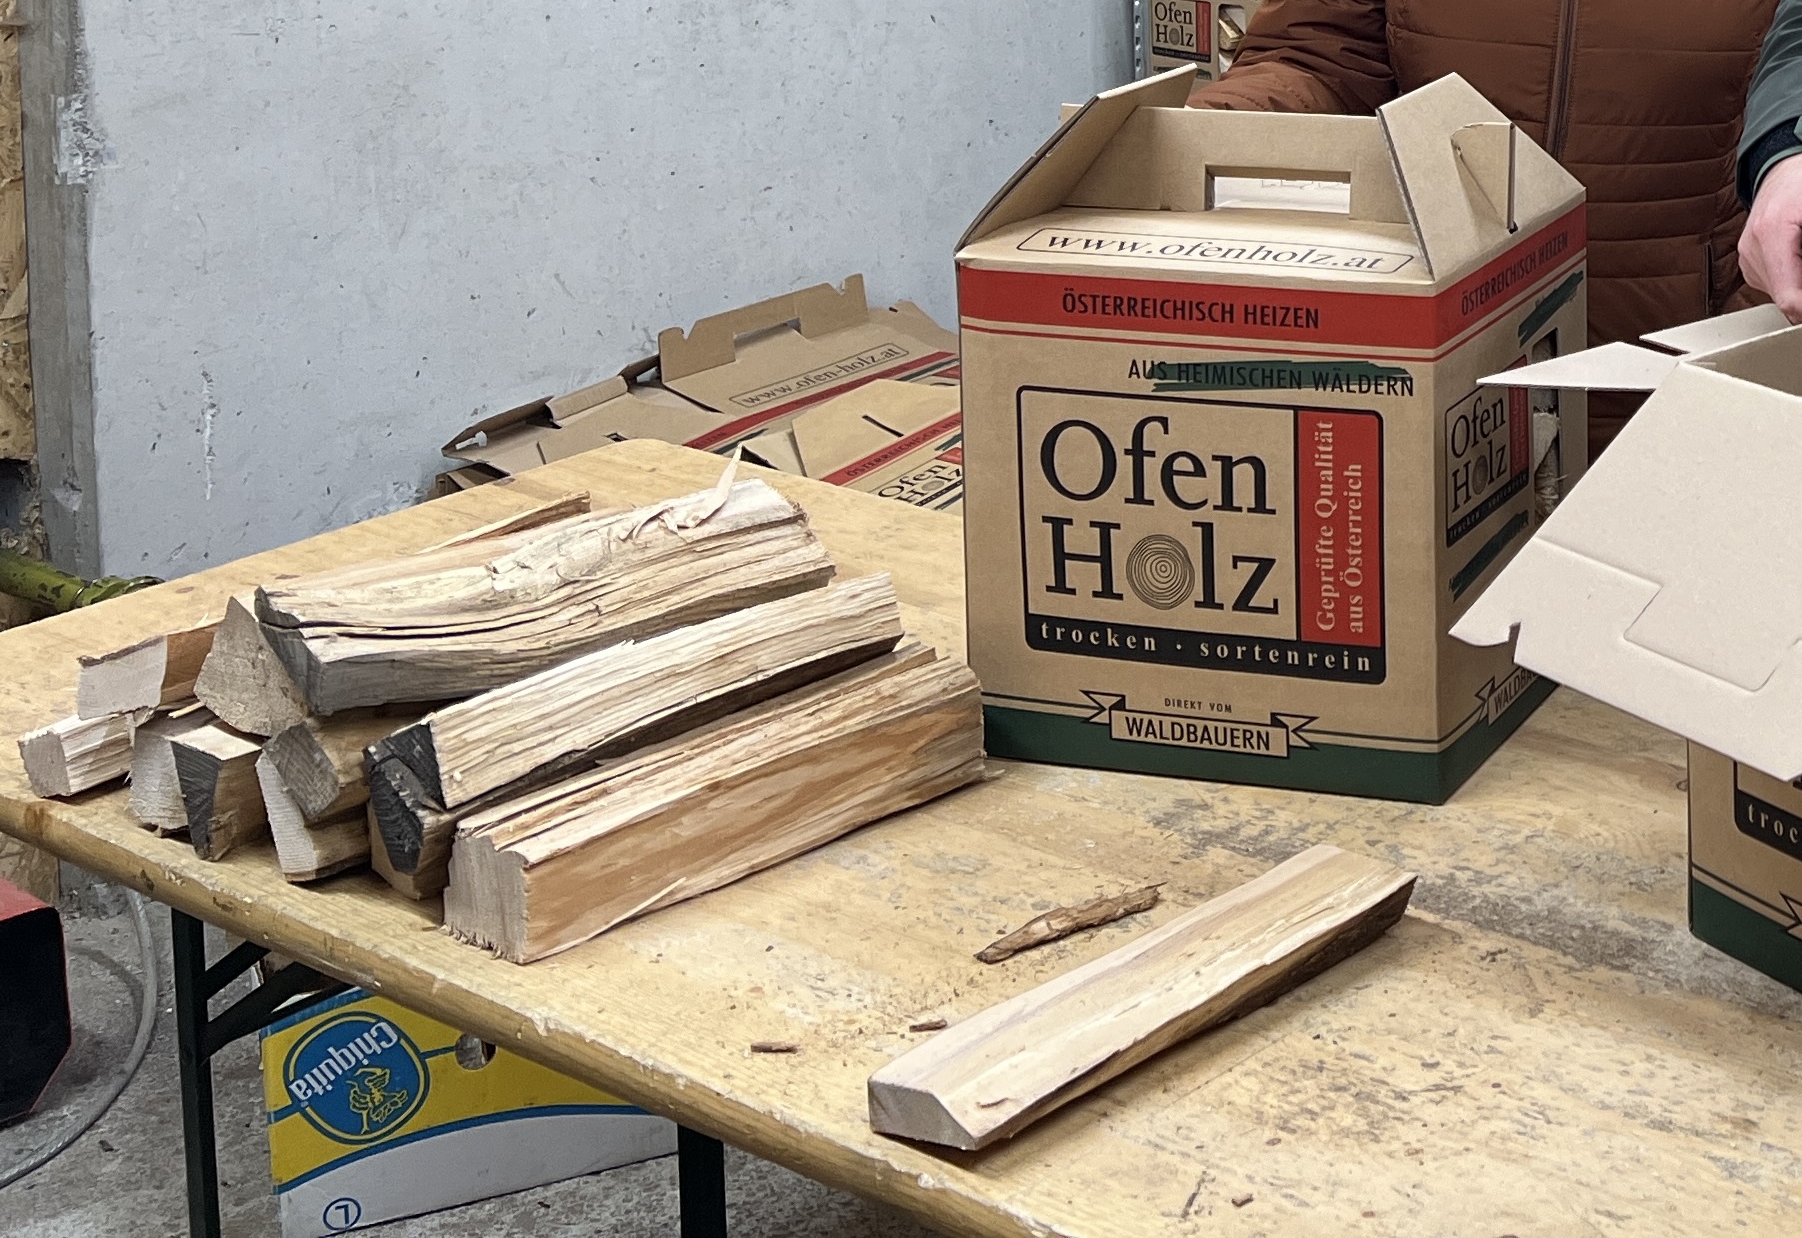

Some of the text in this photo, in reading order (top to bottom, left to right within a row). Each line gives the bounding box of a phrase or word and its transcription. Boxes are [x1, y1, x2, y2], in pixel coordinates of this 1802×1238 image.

[1154, 2, 1193, 24] Ofen
[1156, 24, 1194, 47] Holz
[1048, 235, 1385, 269] www.ofenholz.at
[1461, 230, 1569, 317] ÖSTERREICHISCH HEIZEN
[1062, 288, 1319, 329] ÖSTERREICHISCH HEIZEN
[1128, 359, 1413, 397] AUS HEIMISCHEN WÄLDERN
[1451, 398, 1506, 460] Ofen
[878, 464, 948, 498] Ofen
[1039, 416, 1277, 515] Ofen
[1451, 441, 1507, 514] Holz
[1314, 421, 1338, 632] Geprüfte Qualität
[1343, 463, 1364, 634] aus Österreich
[1041, 515, 1280, 616] Holz
[1041, 622, 1372, 672] trocken sortenrein
[1164, 698, 1232, 713] DIREKT VOM
[1125, 716, 1270, 751] WALDBAUERN
[289, 1021, 399, 1103] Chiquita
